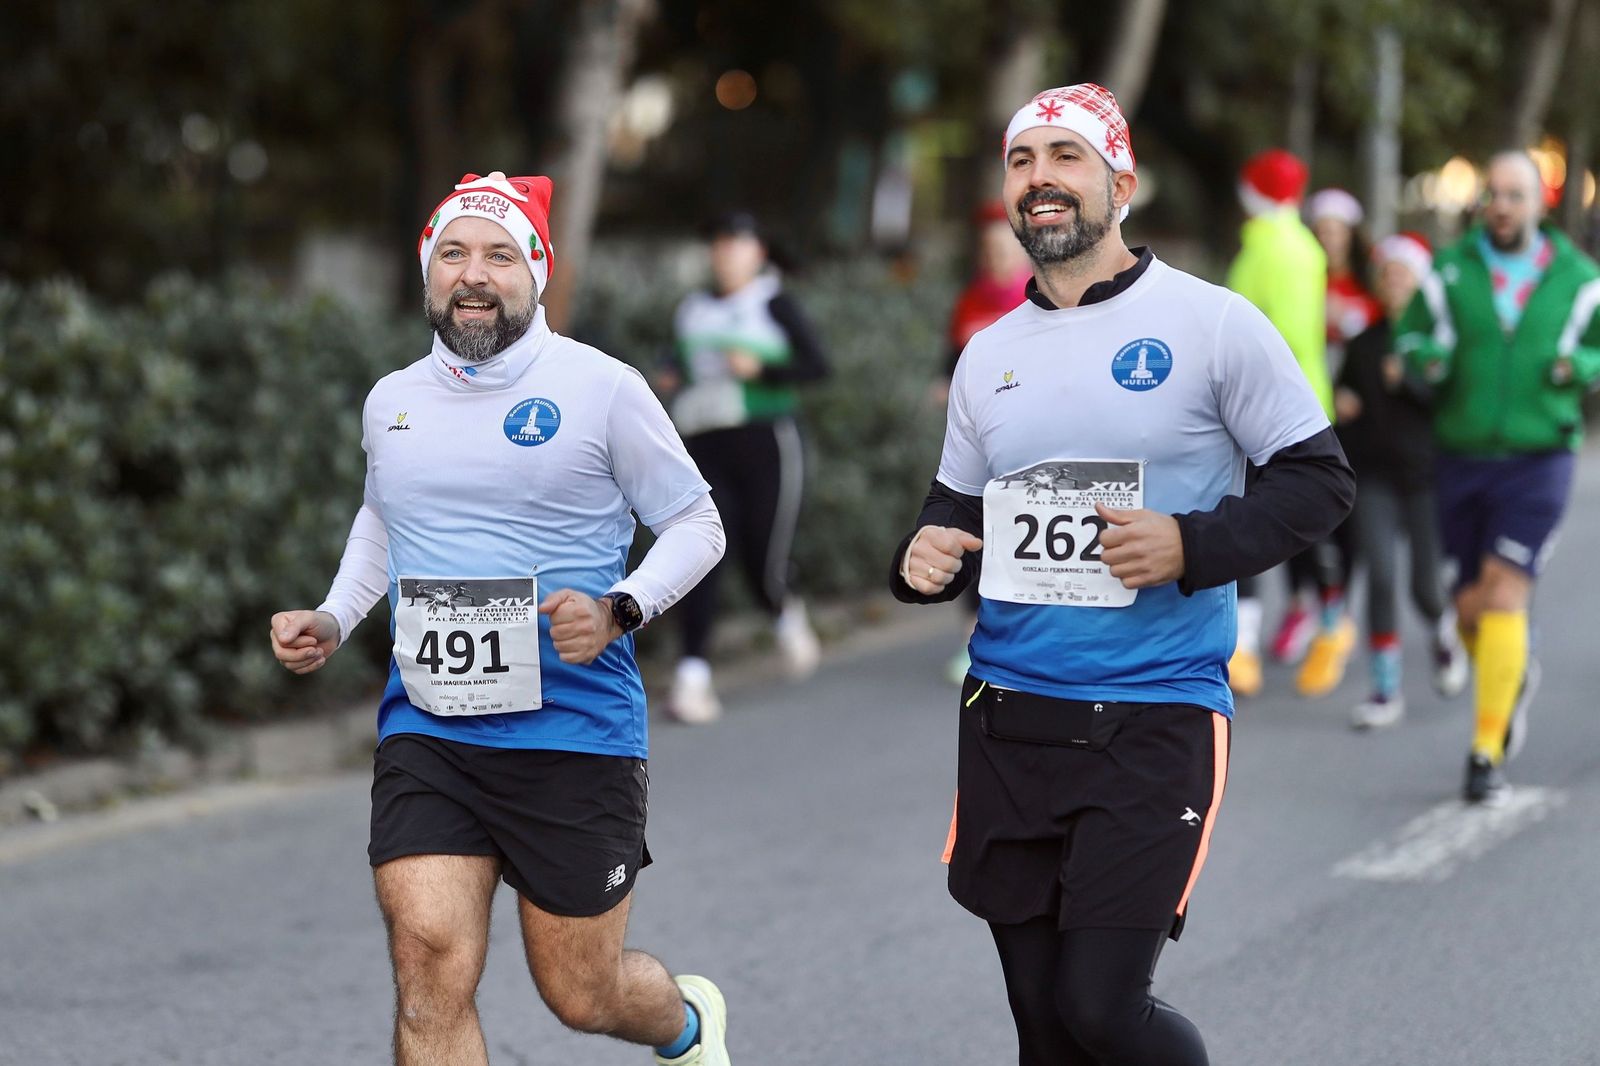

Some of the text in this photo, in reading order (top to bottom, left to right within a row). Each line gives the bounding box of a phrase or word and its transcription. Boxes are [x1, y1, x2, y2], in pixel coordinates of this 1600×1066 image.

[460, 194, 510, 212] MERRY
[460, 202, 506, 219] X-MAS
[511, 434, 546, 442] HUELIN
[1085, 481, 1138, 491] XIV
[1014, 513, 1108, 562] 262
[484, 596, 533, 607] XIV
[416, 630, 510, 675] 491
